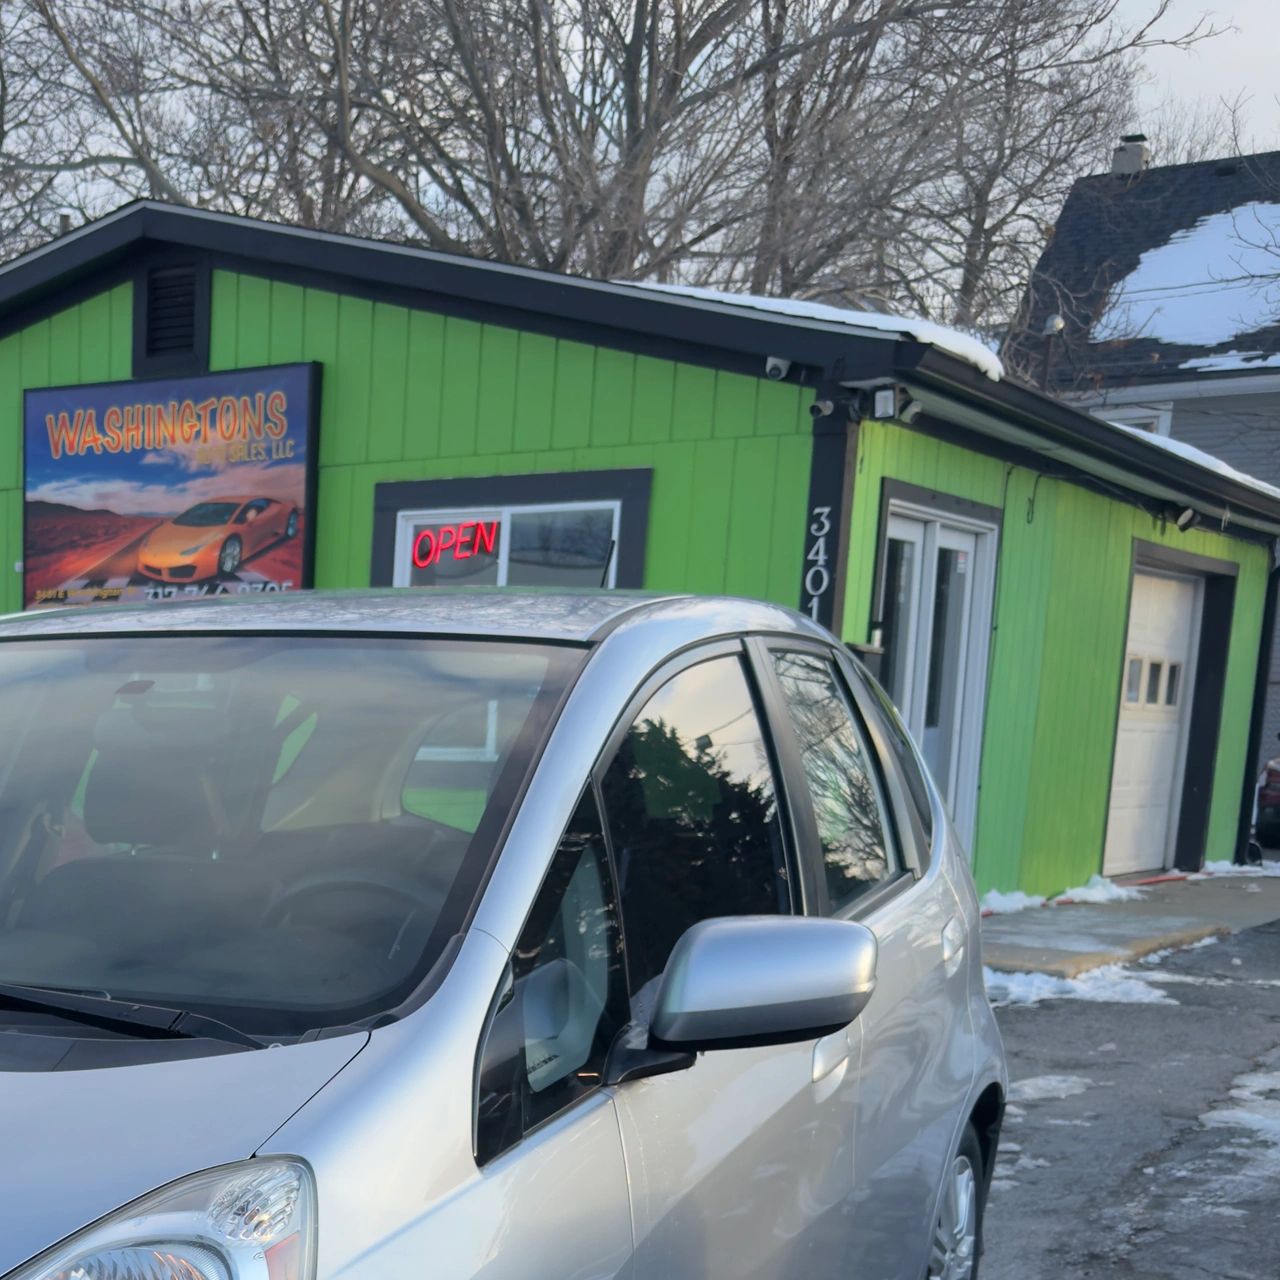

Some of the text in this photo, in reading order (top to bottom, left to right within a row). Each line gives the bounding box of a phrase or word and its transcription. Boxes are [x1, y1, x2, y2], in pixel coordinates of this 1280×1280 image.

[45, 391, 288, 459] WASHINGTONS
[272, 440, 295, 460] LLC
[412, 520, 498, 569] OPEN
[805, 506, 832, 621] 3401
